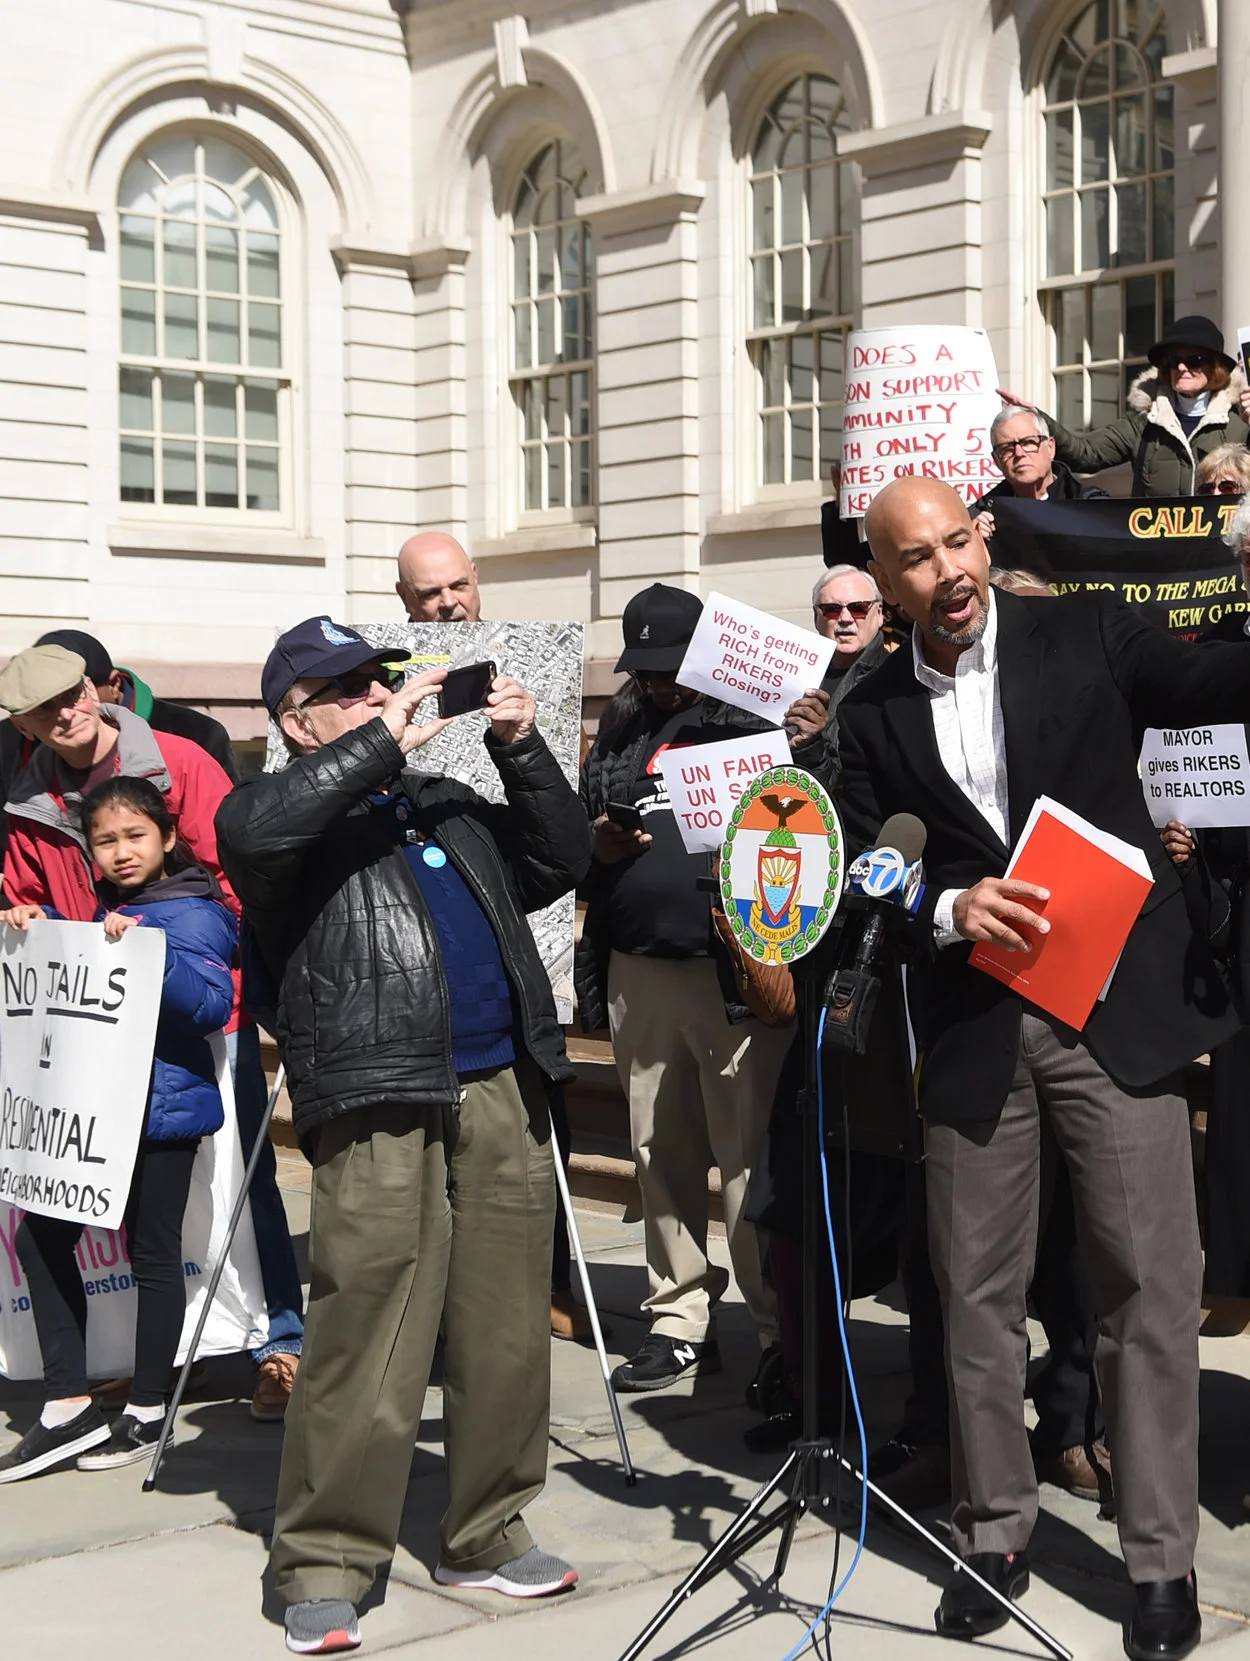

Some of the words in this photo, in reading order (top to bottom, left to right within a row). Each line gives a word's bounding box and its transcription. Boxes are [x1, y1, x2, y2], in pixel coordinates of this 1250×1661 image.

[853, 344, 917, 369] DOES
[935, 344, 954, 362] A
[882, 370, 983, 398] SUPPORT
[843, 402, 957, 429] MMUNITY
[844, 443, 862, 460] TH
[876, 433, 946, 457] ONLY
[964, 428, 987, 453] 5
[841, 464, 887, 484] ATES
[893, 462, 915, 479] ON
[921, 458, 1005, 479] RIKERS
[1128, 506, 1212, 538] CALL
[1217, 504, 1239, 536] T
[1122, 583, 1151, 604] TO
[1156, 582, 1190, 602] THE
[1192, 575, 1237, 599] MEGA
[1168, 609, 1205, 629] KEW
[713, 611, 759, 640] Who's
[763, 633, 819, 666] getting
[718, 633, 758, 659] RICH
[763, 651, 800, 675] from
[721, 654, 784, 688] RIKERS
[711, 668, 782, 704] Closing?
[1162, 730, 1214, 747] MAYOR
[681, 765, 711, 785] UN
[723, 753, 774, 778] FAIR
[1148, 759, 1179, 776] gives
[1182, 754, 1241, 772] RIKERS
[686, 787, 717, 807] UN
[1150, 783, 1162, 798] to
[1164, 780, 1245, 798] REALTORS
[681, 810, 723, 831] TOO
[849, 863, 870, 876] abc
[864, 852, 902, 896] 7
[760, 927, 778, 940] CEDE
[2, 961, 37, 1005] NO
[46, 955, 127, 1011] JAILS
[42, 1034, 52, 1057] IN
[3, 1087, 106, 1164] RESIDENTIAL
[0, 1168, 111, 1217] EIGHBORHOODS
